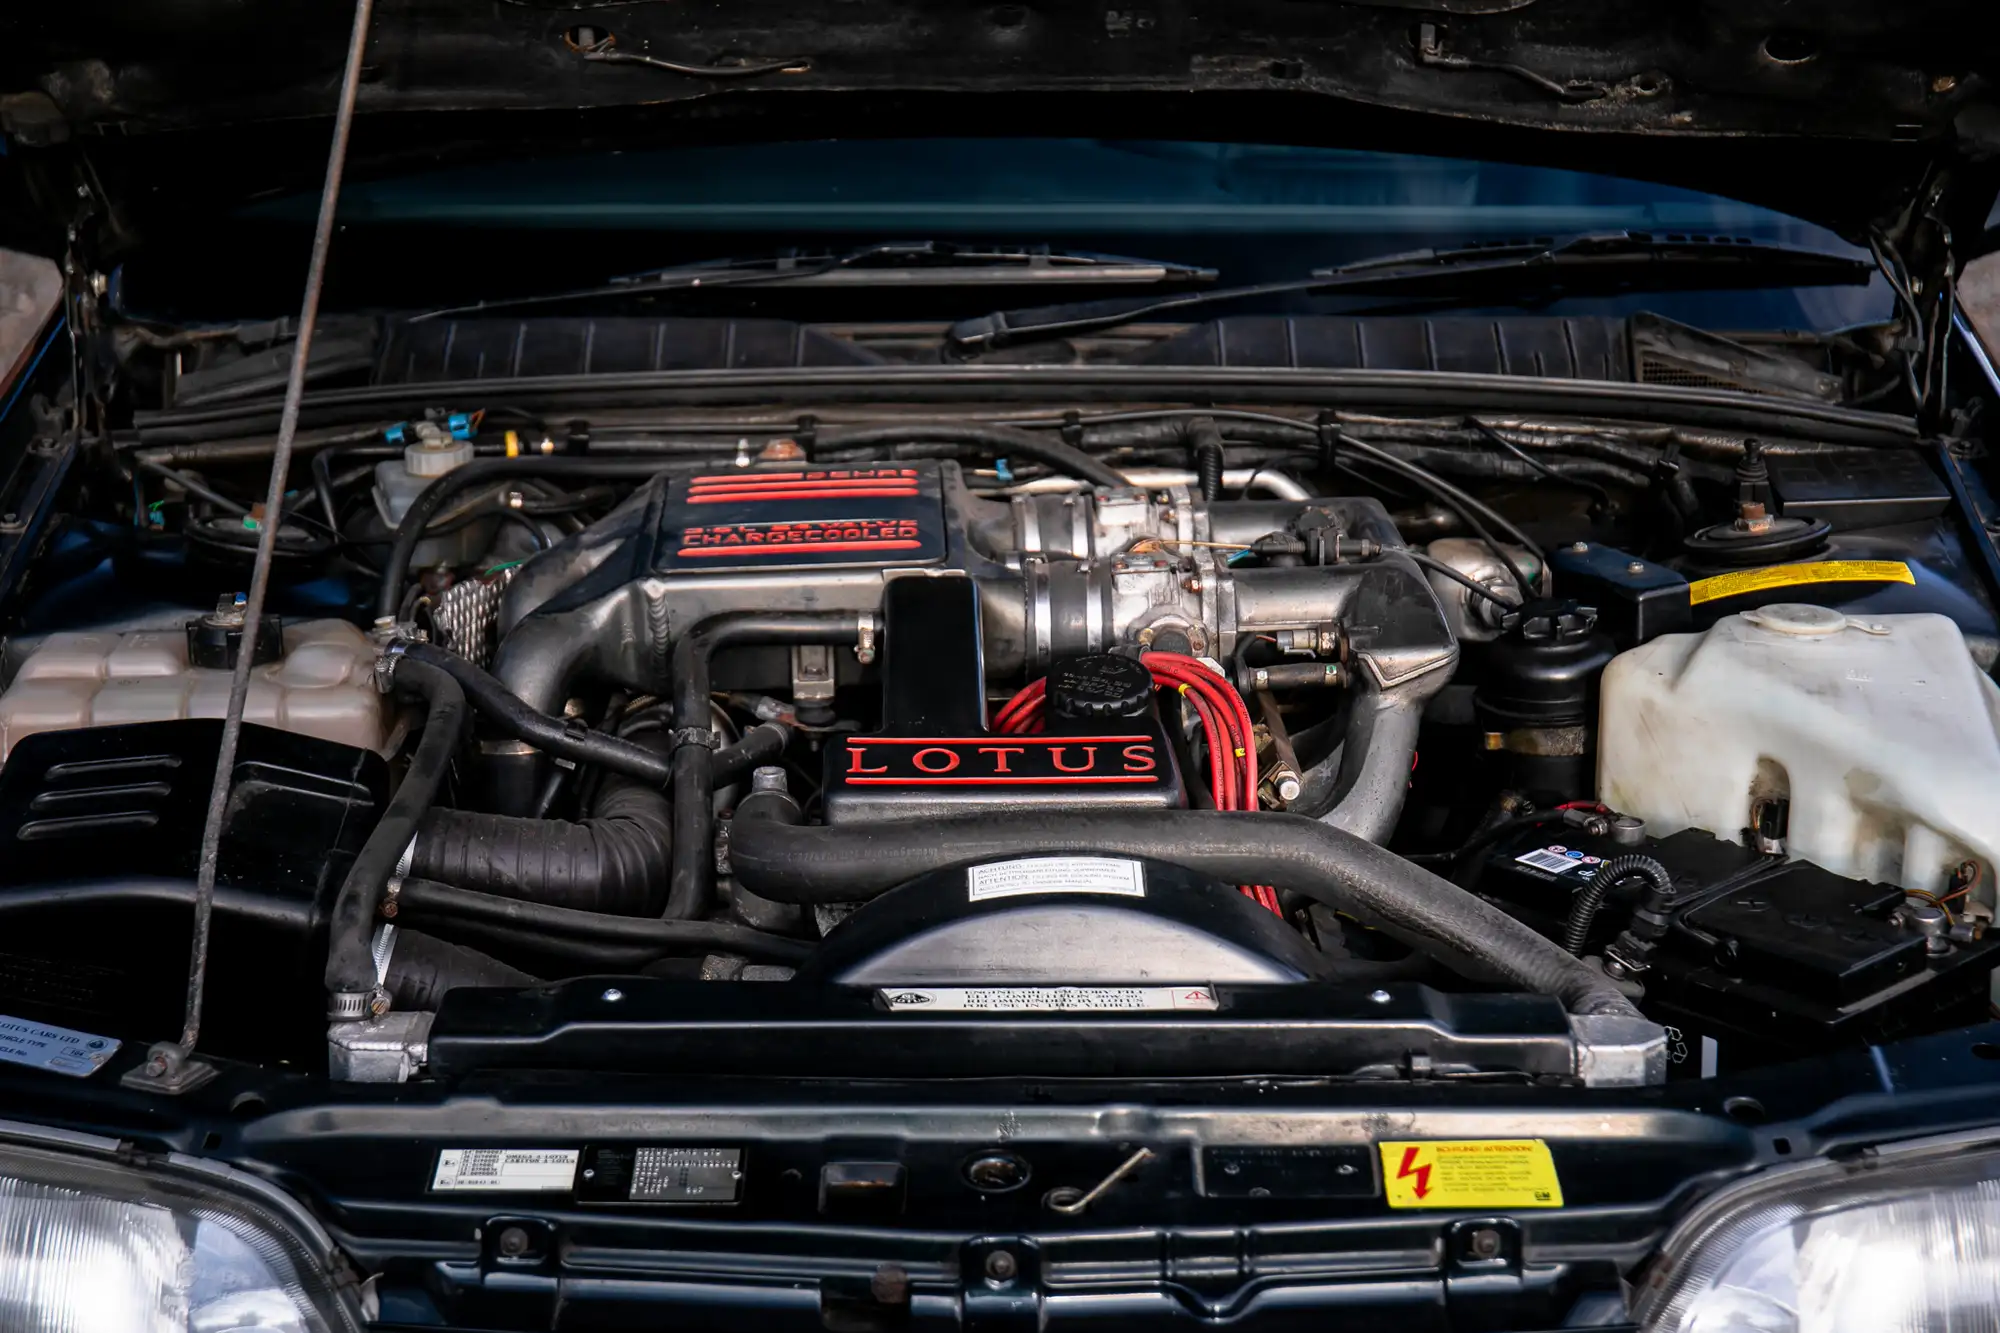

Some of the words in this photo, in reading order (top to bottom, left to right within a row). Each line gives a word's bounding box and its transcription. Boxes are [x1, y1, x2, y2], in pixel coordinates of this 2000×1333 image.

[682, 527, 919, 546] CHARGECOOLED
[846, 745, 1157, 774] LOTUS
[0, 1021, 29, 1033] OTUS
[30, 1028, 58, 1039] CARS
